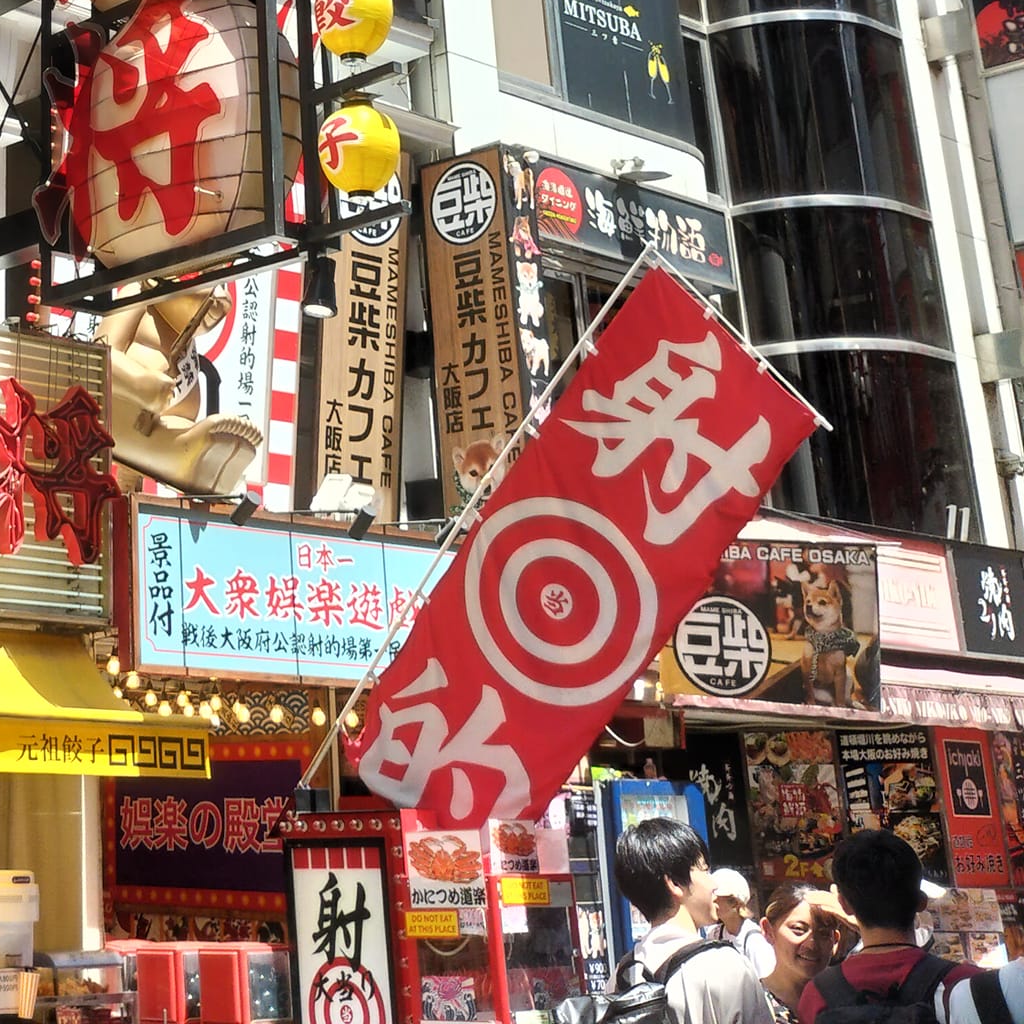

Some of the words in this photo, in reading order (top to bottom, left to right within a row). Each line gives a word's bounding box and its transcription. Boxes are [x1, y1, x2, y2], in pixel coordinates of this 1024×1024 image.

[456, 226, 475, 237] CAFE
[487, 231, 514, 382] MAMESHIBA
[382, 247, 401, 404] MAMESHIBA
[439, 362, 464, 435] 大阪店
[379, 415, 394, 489] CAFE
[297, 540, 355, 573] 日本一
[756, 546, 803, 564] CAFE
[808, 548, 870, 566] OSAKA
[147, 531, 175, 637] 景品付
[709, 677, 737, 687] CAFE
[16, 732, 105, 765] 元祖餃子
[411, 886, 486, 906] かにつめ道楽
[312, 871, 372, 973] 射
[408, 924, 417, 933] AT
[417, 924, 434, 933] THIS
[435, 924, 457, 933] PLACE
[411, 914, 423, 923] DO
[424, 914, 438, 923] NOT
[439, 914, 453, 923] EAT
[313, 970, 376, 1004] 大当り
